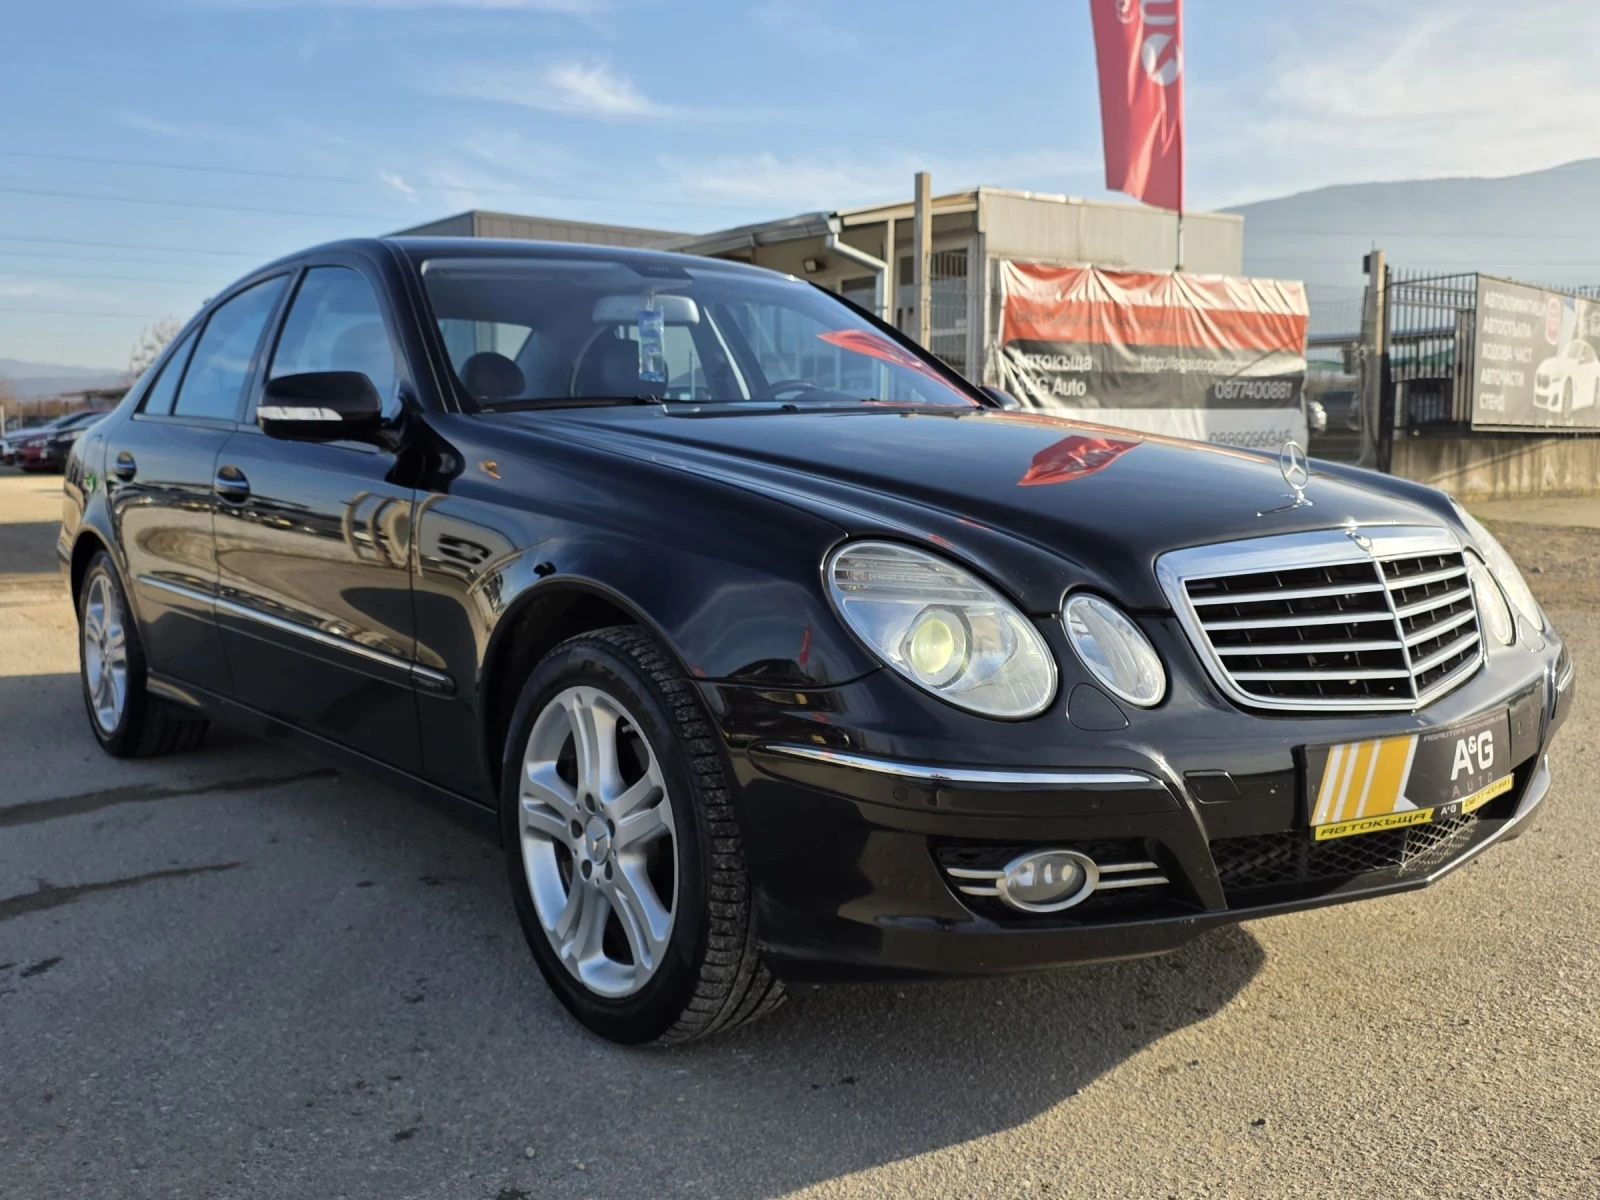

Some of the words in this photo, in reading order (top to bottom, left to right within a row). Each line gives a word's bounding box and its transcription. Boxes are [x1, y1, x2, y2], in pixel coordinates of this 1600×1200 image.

[1052, 377, 1087, 397] Auto
[1214, 381, 1293, 400] 0877400881
[1450, 729, 1494, 781] A&G
[1452, 773, 1493, 798] AUTO
[1320, 812, 1426, 837] АВТОКЪЩА
